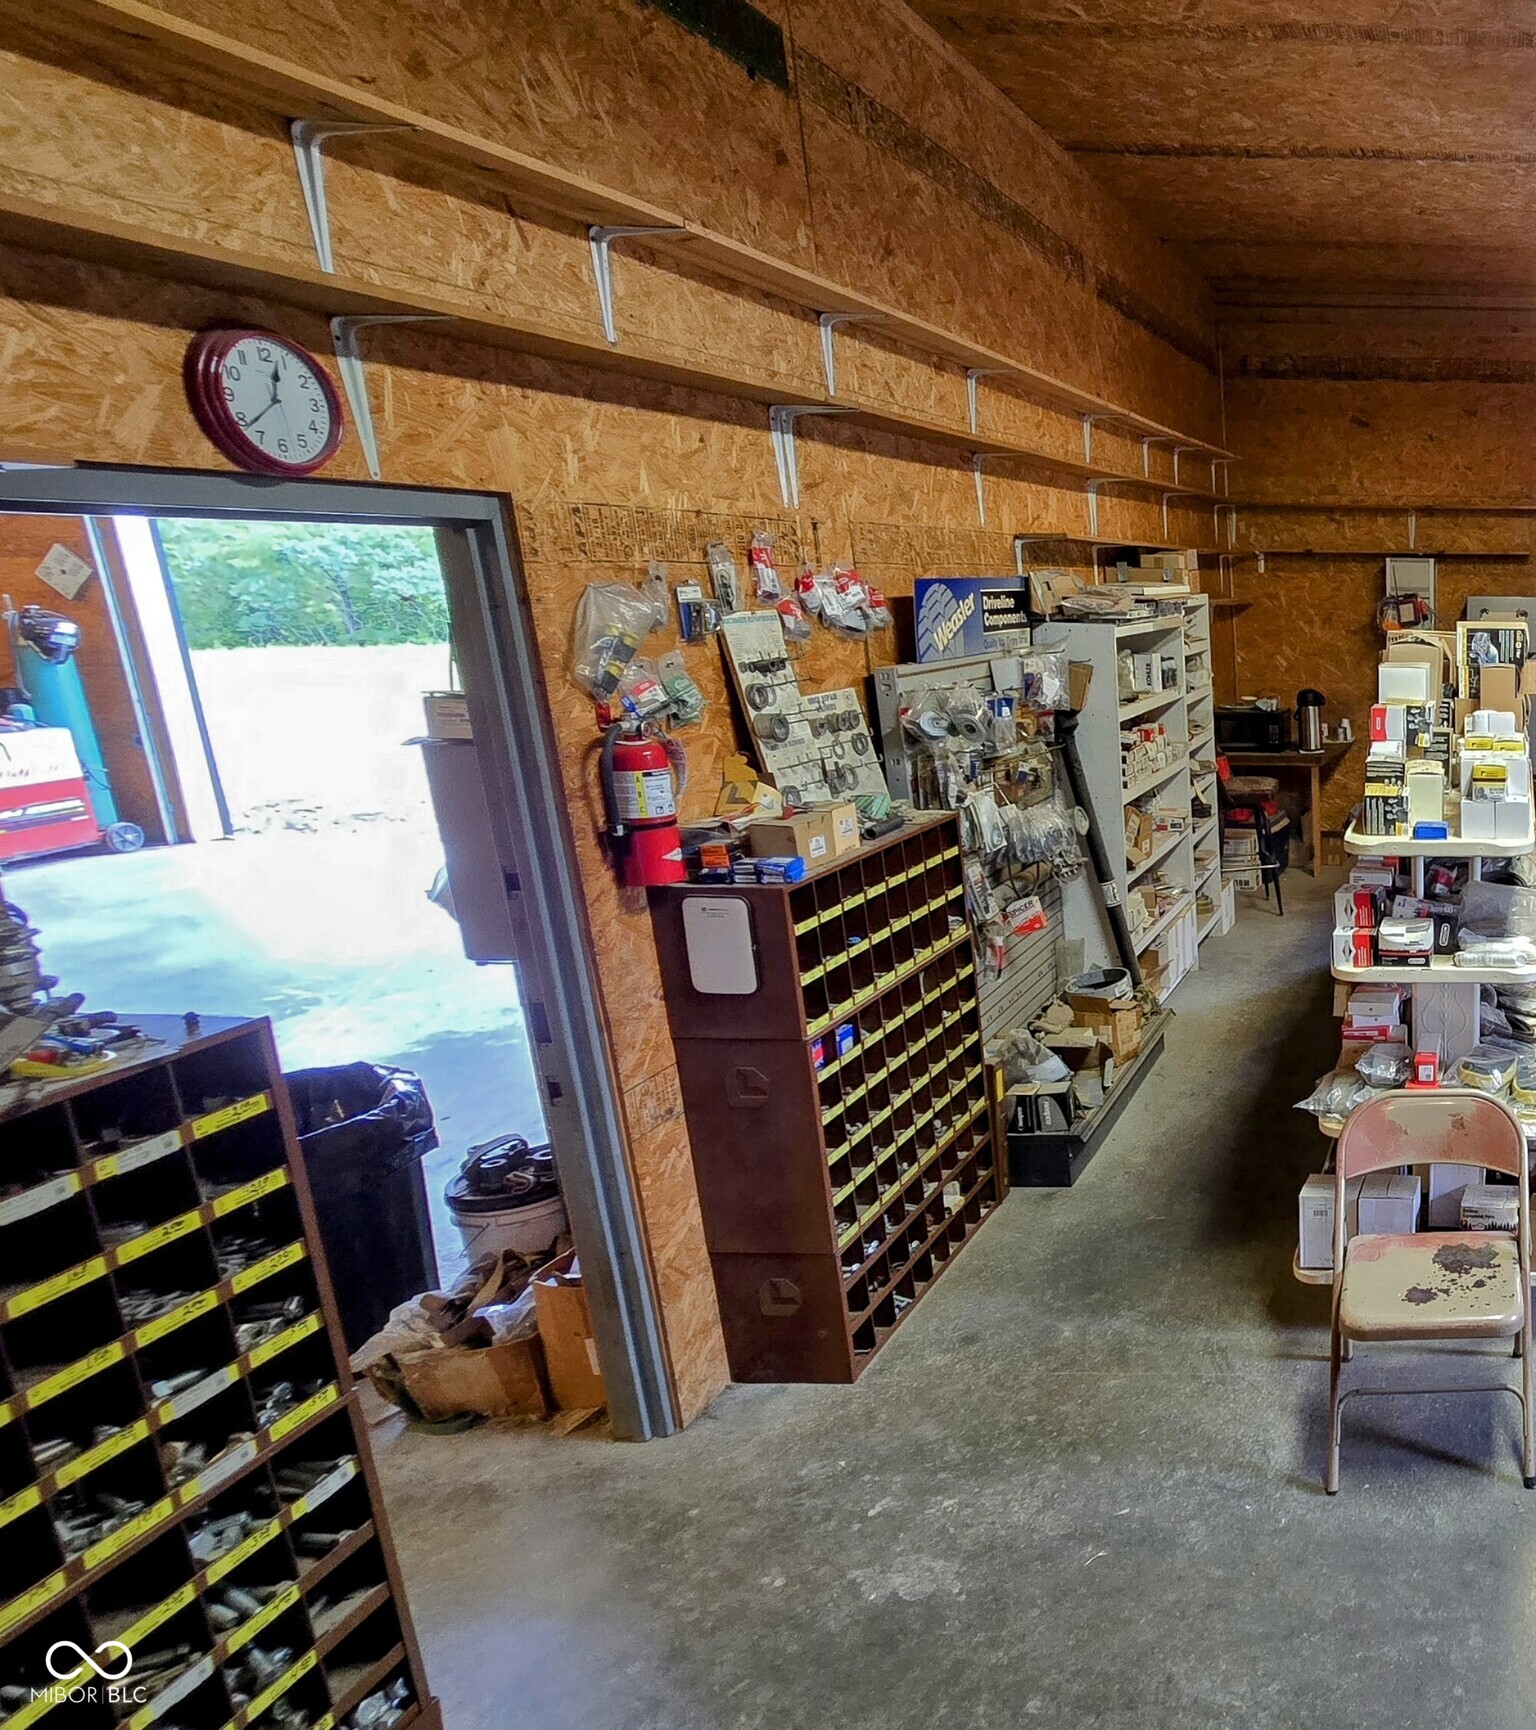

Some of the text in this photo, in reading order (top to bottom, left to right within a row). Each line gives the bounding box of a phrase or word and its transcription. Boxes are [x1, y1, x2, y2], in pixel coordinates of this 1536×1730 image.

[237, 349, 248, 365] 11
[256, 346, 273, 363] 12
[280, 355, 288, 371] 1
[224, 365, 241, 382] 10
[298, 374, 310, 389] 2
[224, 387, 235, 402] 9
[309, 398, 320, 413] 3
[236, 411, 247, 427] 8
[308, 419, 319, 434] 4
[255, 430, 265, 446] 7
[277, 438, 289, 453] 6
[296, 434, 308, 449] 5
[982, 595, 1015, 610] Driveline
[932, 592, 976, 653] Weasler
[984, 611, 1028, 628] Components
[1009, 900, 1034, 916] SPICER
